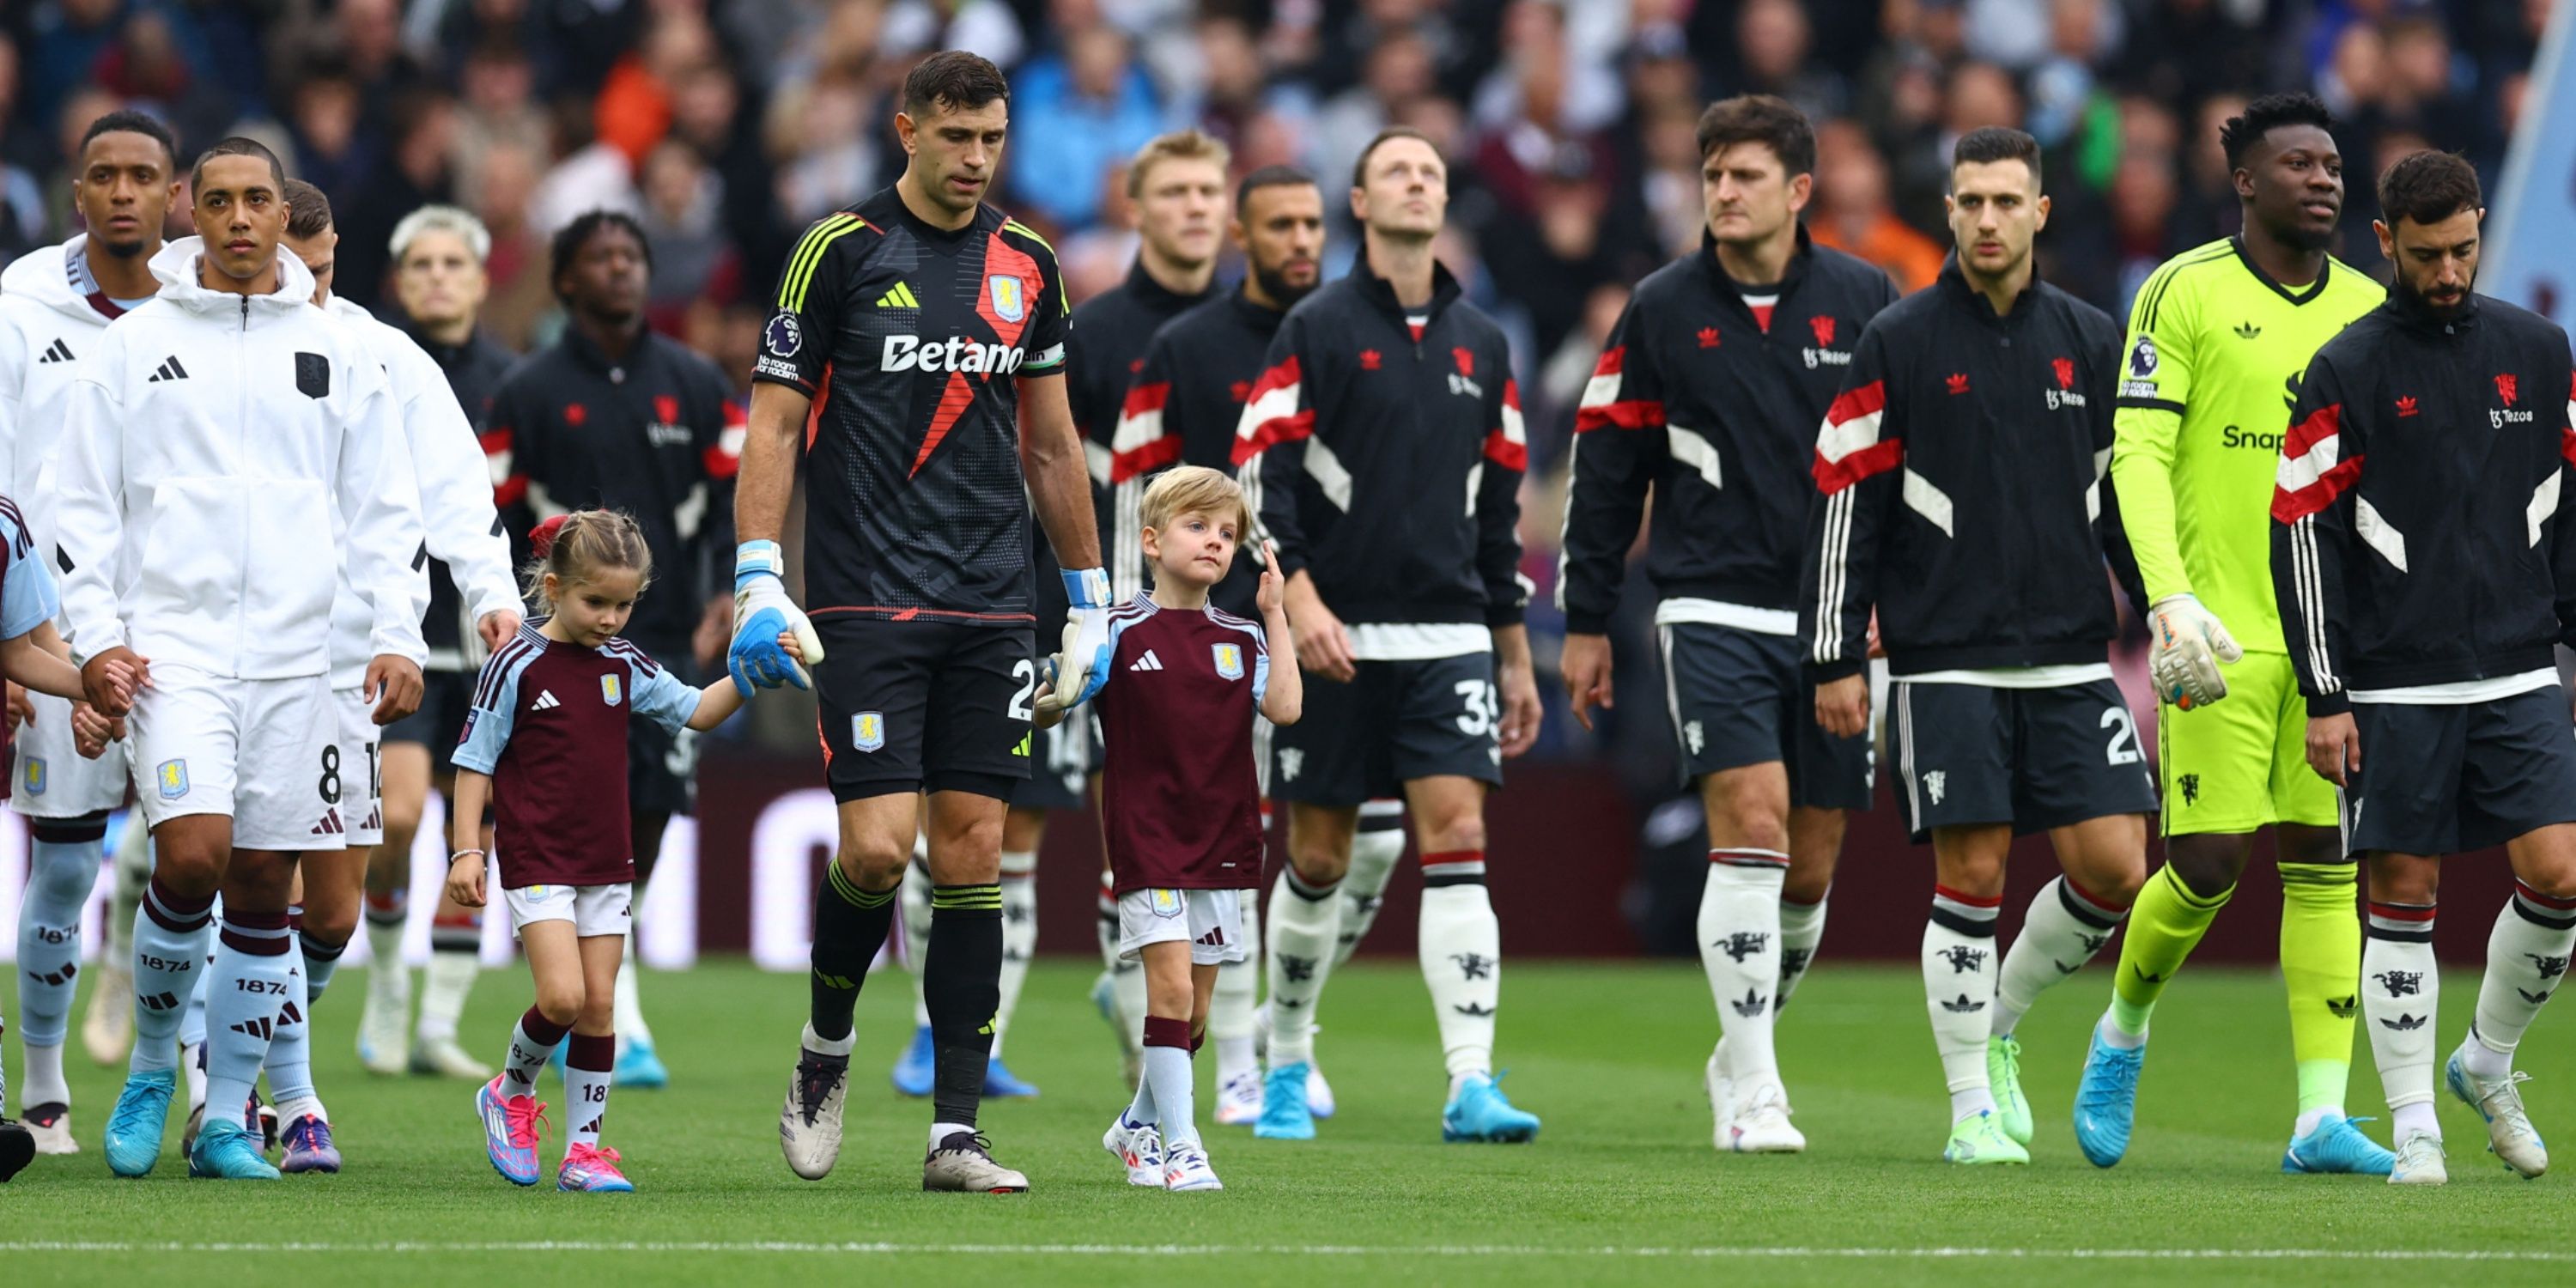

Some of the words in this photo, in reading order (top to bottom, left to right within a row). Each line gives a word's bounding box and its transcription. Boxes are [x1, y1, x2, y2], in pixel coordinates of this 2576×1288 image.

[758, 354, 769, 365] No
[771, 359, 796, 372] room
[881, 334, 1025, 374] Betano
[768, 367, 799, 380] racism
[2501, 409, 2533, 423] Tezos
[2099, 706, 2147, 766] 2
[319, 744, 342, 805] 8
[140, 954, 191, 973] 1874
[235, 978, 288, 996] 1874
[583, 1083, 610, 1103] 18
